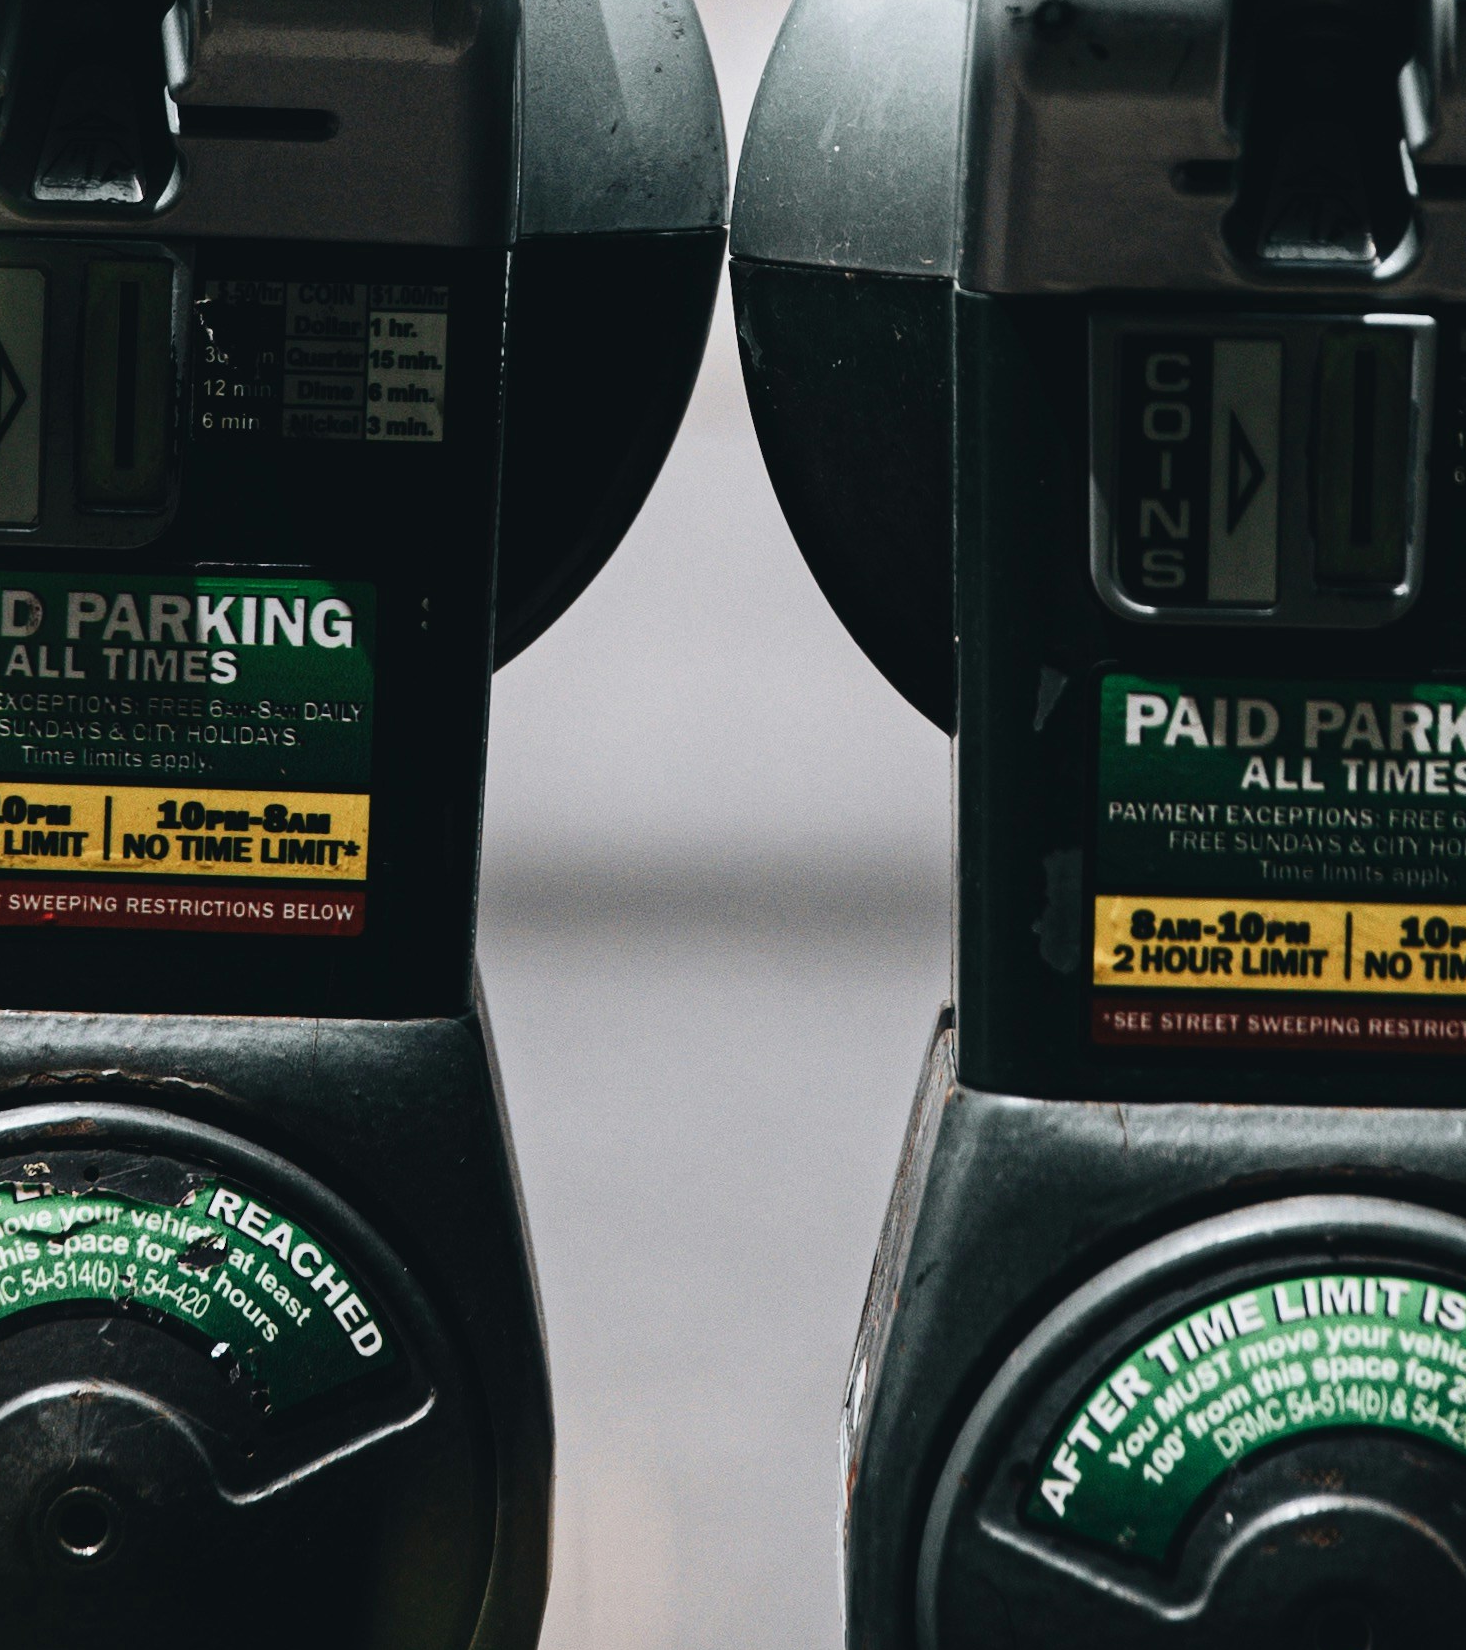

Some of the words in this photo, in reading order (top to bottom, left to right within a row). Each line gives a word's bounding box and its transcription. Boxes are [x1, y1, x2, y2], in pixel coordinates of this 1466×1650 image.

[298, 283, 355, 305] COIN
[295, 316, 361, 336] Dollar
[370, 319, 381, 337] 1
[390, 318, 417, 338] hr.
[287, 348, 363, 369] Quarter
[370, 351, 394, 370] 15
[399, 352, 442, 371] min.
[298, 380, 354, 400] Dime
[369, 383, 382, 402] 6
[387, 384, 435, 403] min.
[291, 414, 359, 434] Nickel
[367, 417, 380, 436] 3
[387, 418, 434, 436] min.
[1138, 352, 1192, 589] COINS
[65, 592, 355, 650] PARKING
[4, 645, 88, 680] ALL
[103, 648, 239, 685] TIMES
[147, 697, 204, 718] FREE
[303, 701, 365, 724] DAILY
[1124, 693, 1280, 748] PAID
[110, 722, 128, 743] &
[134, 723, 178, 744] CITY
[20, 745, 77, 767] Time
[83, 746, 143, 769] limits
[1240, 755, 1326, 792] ALL
[1107, 801, 1218, 825] PAYMENT
[1226, 805, 1381, 831] EXCEPTIONS:
[1388, 809, 1446, 831] FREE
[3, 829, 88, 857] LIMIT
[122, 834, 170, 861] NO
[177, 835, 252, 863] TIME
[1169, 830, 1227, 851] FREE
[1233, 832, 1343, 855] SUNDAYS
[1348, 834, 1367, 855] &
[1373, 836, 1420, 857] CITY
[1258, 859, 1313, 882] Time
[1321, 860, 1383, 883] limits
[8, 894, 118, 914] SWEEPING
[125, 898, 274, 918] RESTRICTIONS
[282, 902, 356, 922] BELOW
[1112, 947, 1134, 973] 2
[1140, 946, 1233, 976] HOUR
[1241, 949, 1329, 979] LIMIT
[1364, 951, 1413, 981] NO
[1160, 1012, 1240, 1034] STREET
[1247, 1015, 1360, 1037] SWEEPING
[58, 1205, 124, 1232] your
[131, 1209, 227, 1250] vehic
[228, 1247, 256, 1276] at
[255, 1262, 313, 1328] least
[208, 1187, 383, 1357] REACHED
[46, 1233, 130, 1261] space
[136, 1234, 177, 1266] for
[213, 1270, 279, 1344] hours
[142, 1268, 211, 1319] 54-420
[1040, 1364, 1153, 1518] AFTER
[1144, 1293, 1266, 1374] TIME
[1272, 1275, 1411, 1323] LIMIT
[1108, 1416, 1159, 1469] You
[1153, 1350, 1234, 1424] MUST
[1239, 1328, 1320, 1370] move
[1324, 1325, 1392, 1352] your
[1186, 1383, 1252, 1440] from
[1250, 1360, 1308, 1399] this
[1311, 1353, 1400, 1385] space
[1404, 1356, 1447, 1392] for
[1212, 1397, 1287, 1460] DRMC
[1390, 1387, 1408, 1421] &
